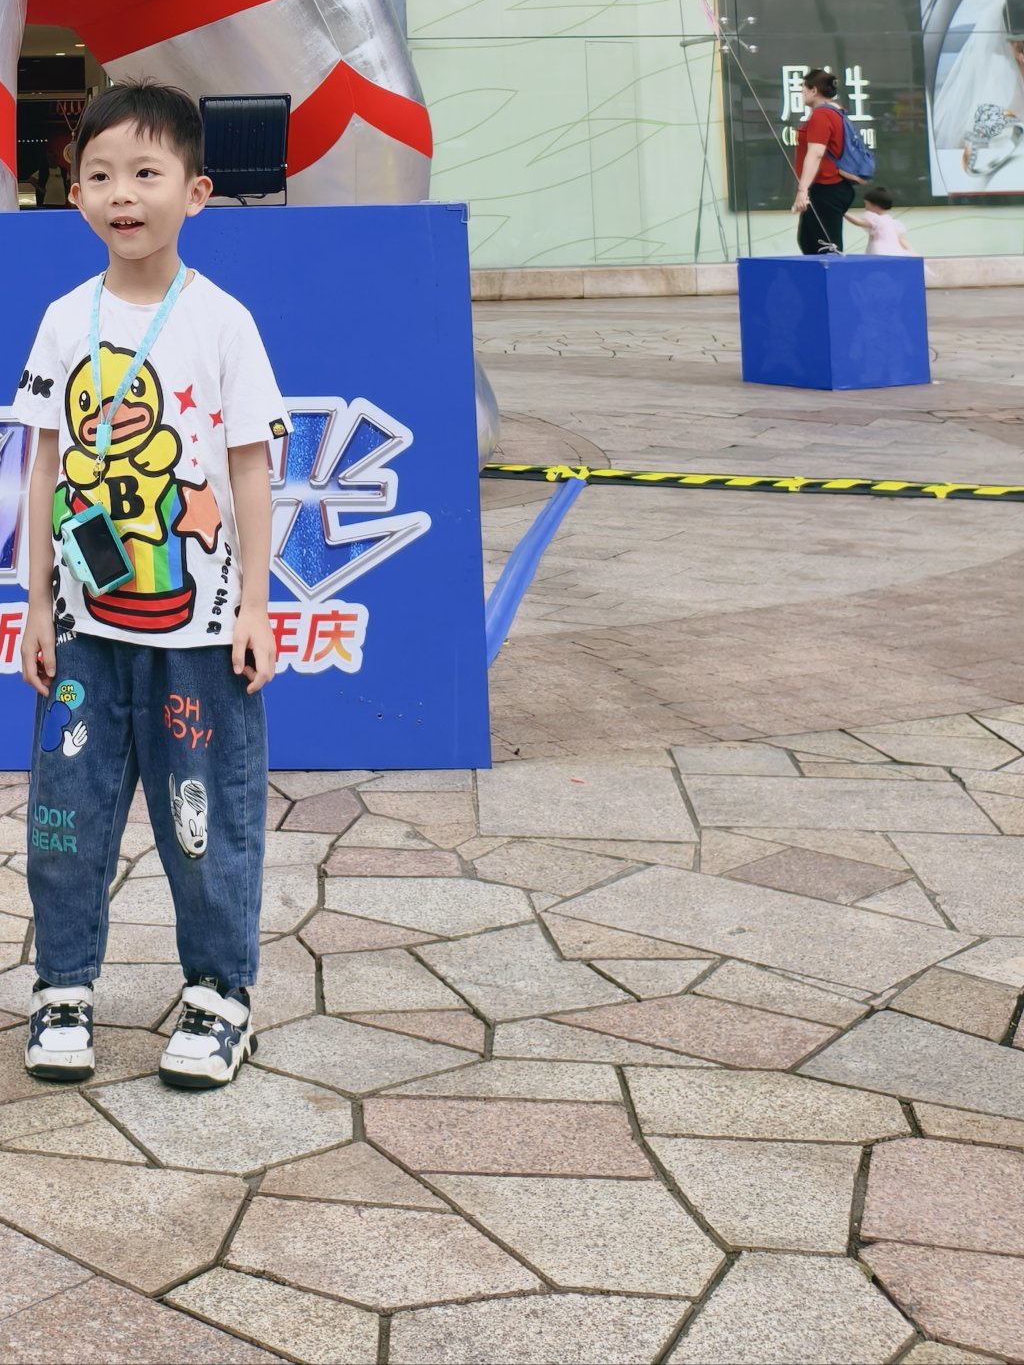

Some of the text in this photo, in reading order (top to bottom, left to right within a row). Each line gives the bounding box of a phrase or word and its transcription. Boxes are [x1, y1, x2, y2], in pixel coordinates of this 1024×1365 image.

[780, 65, 874, 122] 周生
[103, 474, 146, 521] B
[33, 801, 77, 829] LOOK
